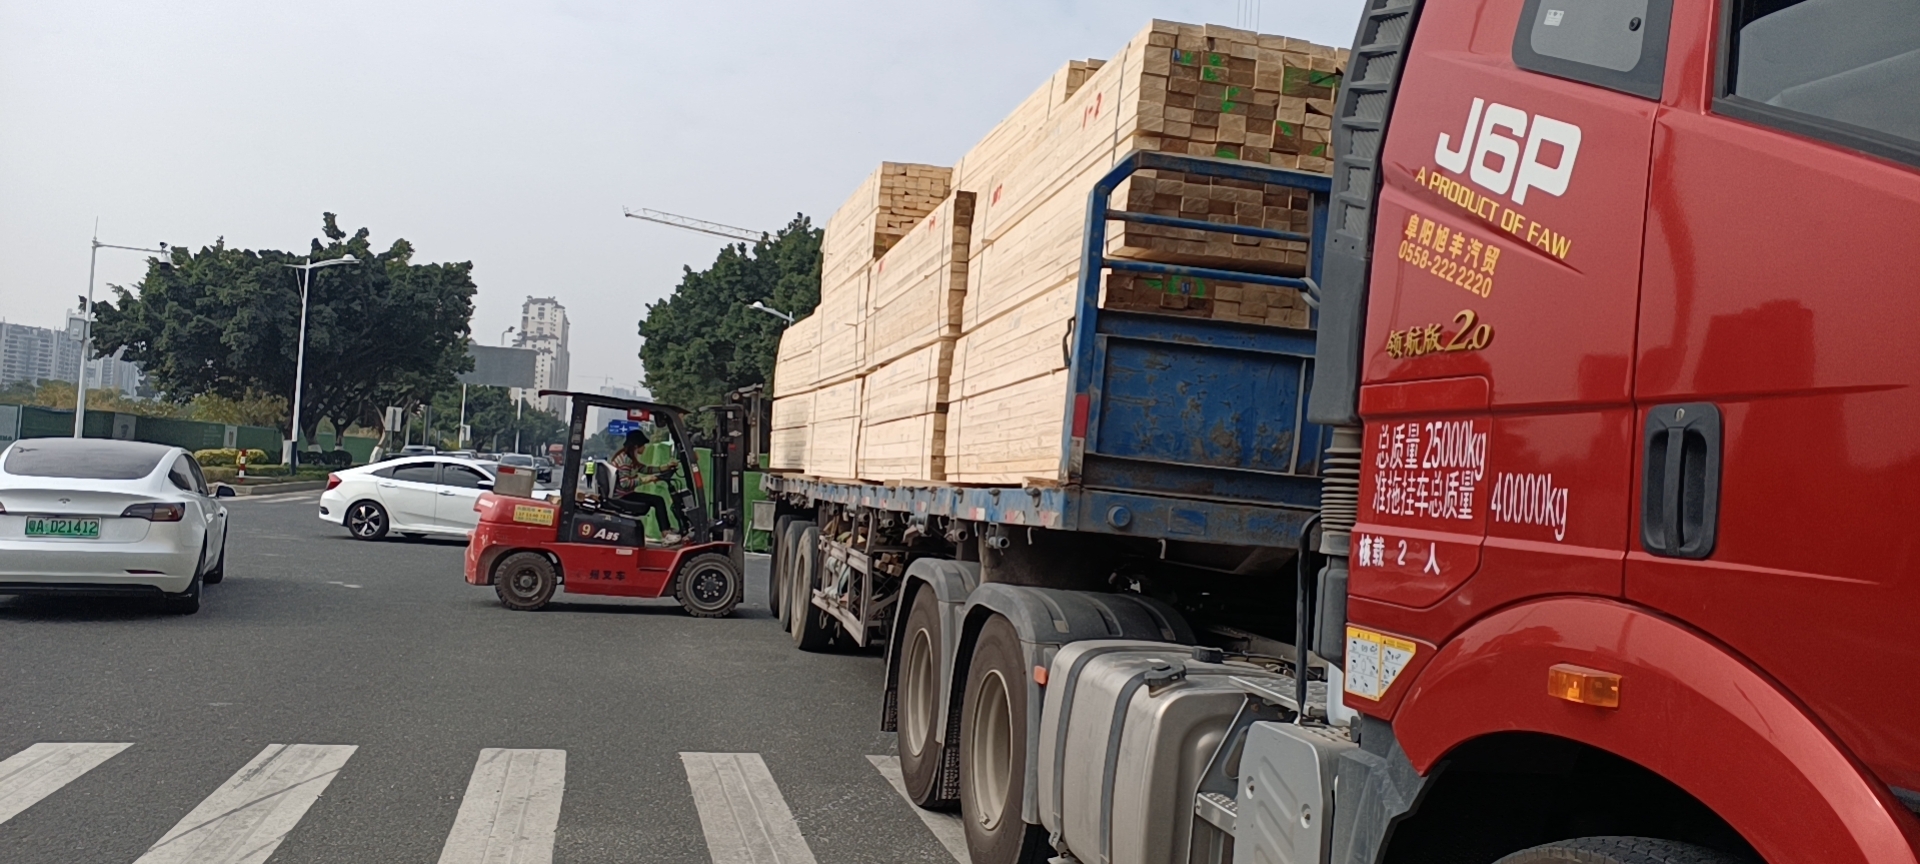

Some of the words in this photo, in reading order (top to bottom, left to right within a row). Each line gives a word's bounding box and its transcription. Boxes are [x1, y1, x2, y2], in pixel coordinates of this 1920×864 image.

[1434, 97, 1582, 206] J6P
[1415, 166, 1427, 186] A
[1428, 171, 1500, 222] PRODUCT
[1501, 208, 1524, 235] OF
[1527, 223, 1572, 260] FAW
[1398, 240, 1493, 299] 0558-2222220
[1404, 213, 1501, 276] 阜阳旭丰汽贸
[1385, 323, 1445, 360] 领航版
[1445, 308, 1496, 352] 2.0
[1375, 423, 1421, 470] 总质量
[1422, 419, 1487, 482] 25000kg
[49, 519, 99, 534] D21412
[581, 523, 592, 536] 9
[1372, 470, 1475, 520] 准拖挂车总质量
[1491, 472, 1569, 542] 40000kg
[1358, 533, 1385, 568] 核载
[1397, 539, 1408, 567] 2
[1423, 542, 1441, 576] 人
